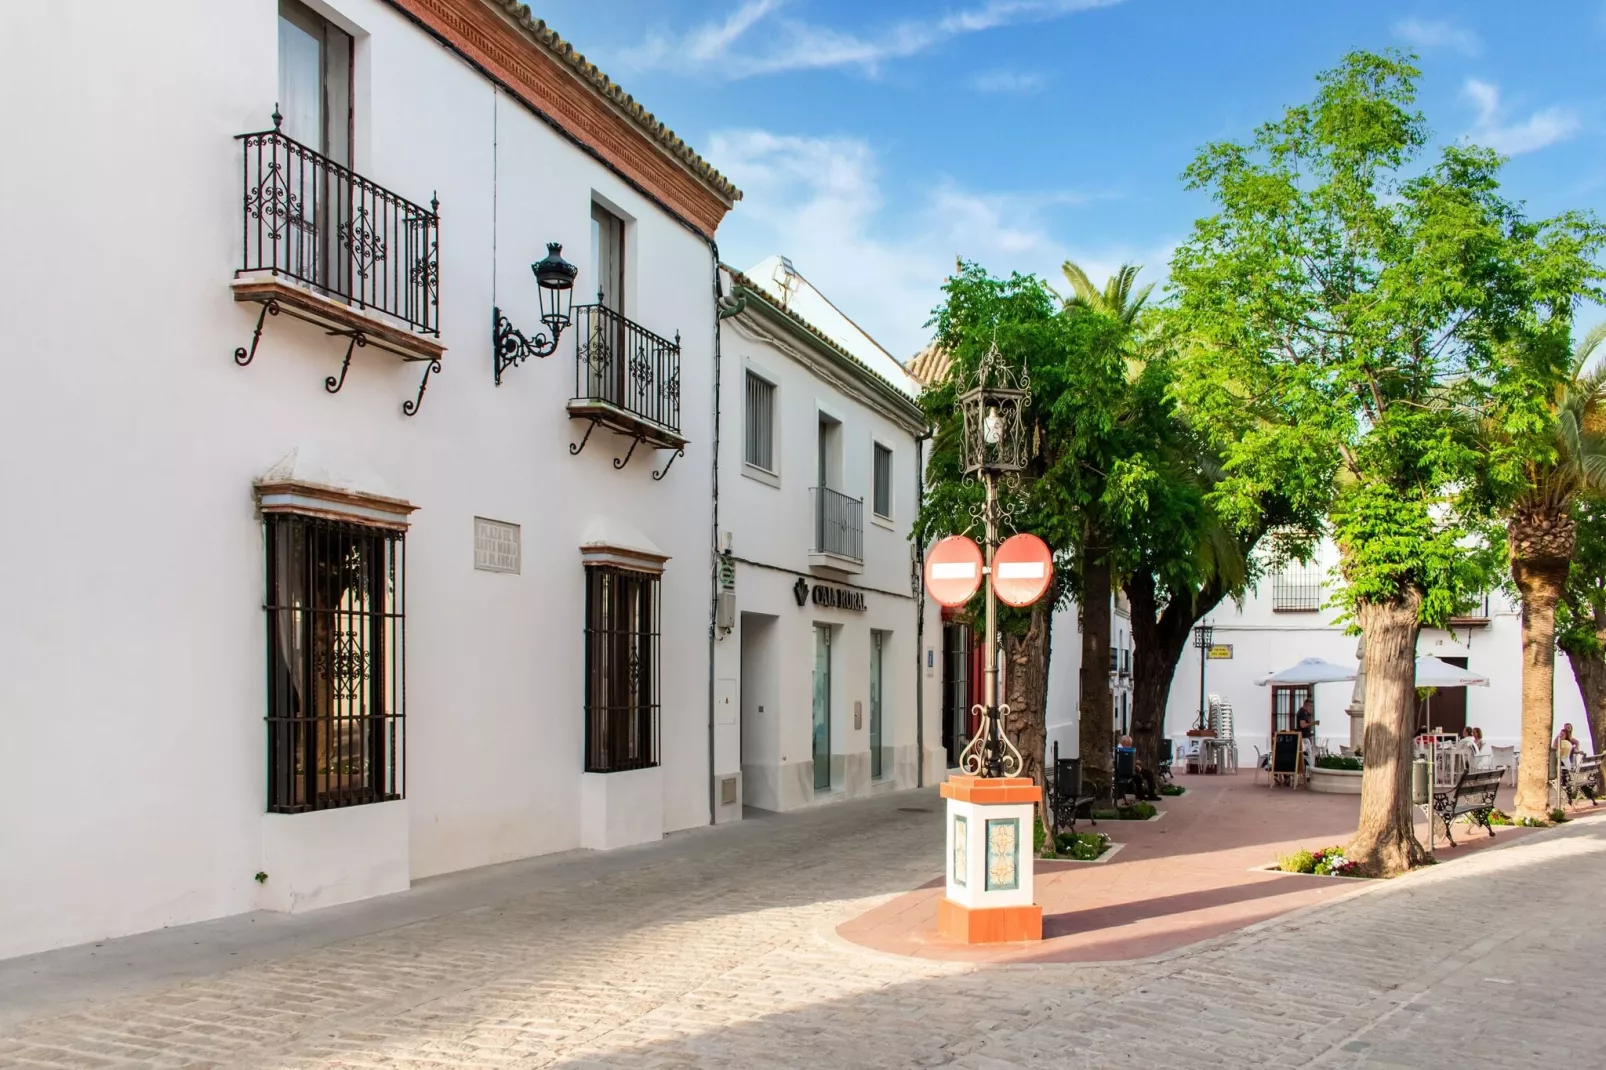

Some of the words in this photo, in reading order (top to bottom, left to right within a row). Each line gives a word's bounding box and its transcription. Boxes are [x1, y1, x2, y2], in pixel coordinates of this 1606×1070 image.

[480, 524, 502, 541] PLAZA
[812, 585, 840, 607] CAJA
[840, 589, 867, 611] RURAL
